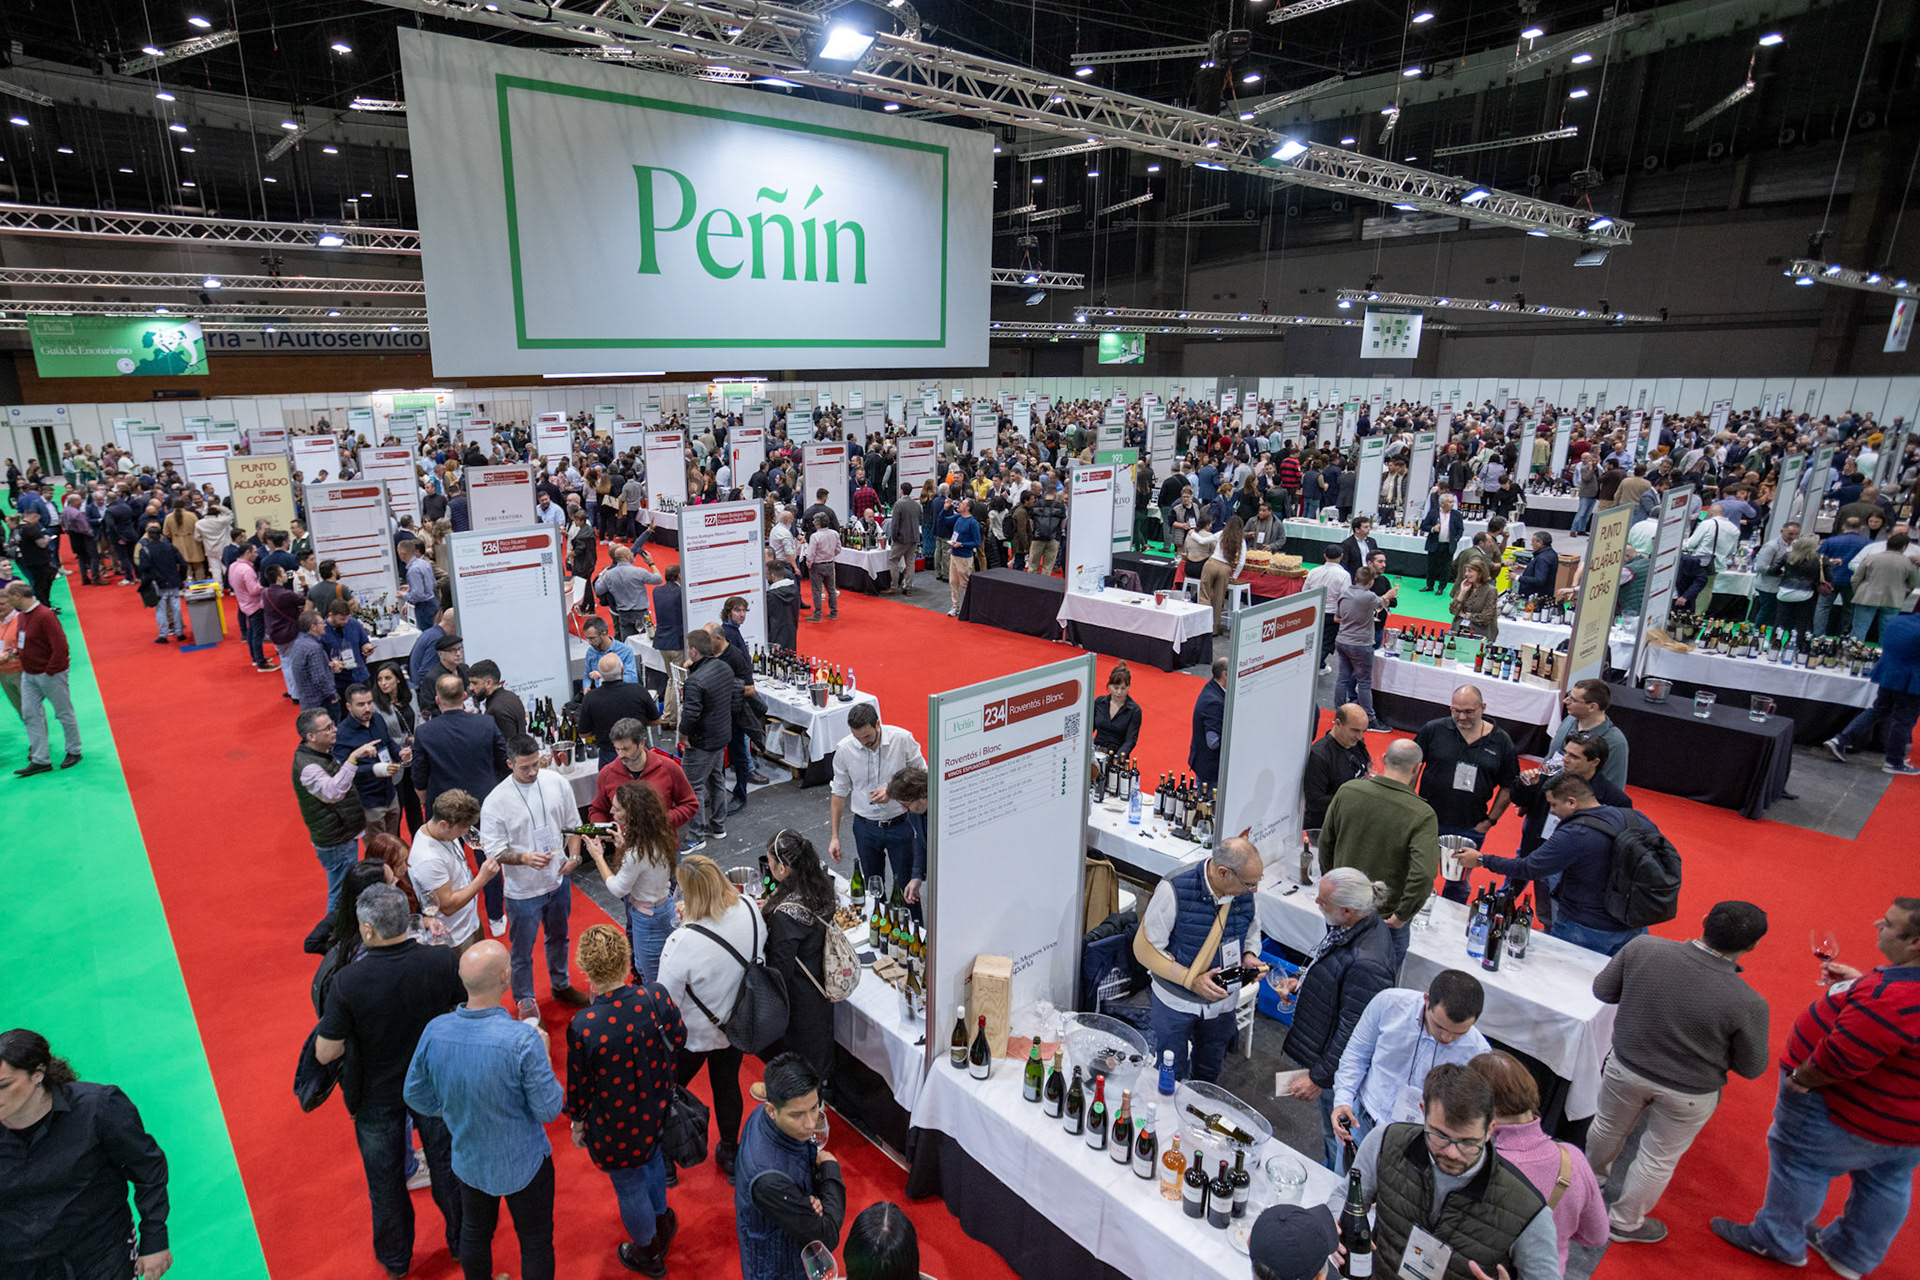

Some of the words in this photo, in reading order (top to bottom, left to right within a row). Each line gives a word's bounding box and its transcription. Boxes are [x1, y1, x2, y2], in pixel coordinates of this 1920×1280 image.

[632, 165, 867, 284] Peñín
[278, 331, 423, 348] Autoservicio
[78, 345, 132, 356] Enoturismo
[1112, 454, 1123, 462] 193
[242, 462, 276, 472] PUNTO
[234, 478, 288, 490] ACLARADO
[246, 494, 281, 504] COPAS
[705, 516, 716, 525] 227
[1600, 521, 1622, 542] PUNTO
[483, 543, 498, 553] 236
[1589, 550, 1622, 573] ACLARADO
[1590, 580, 1612, 600] COPAS
[1286, 618, 1302, 628] Tamayo
[1263, 622, 1274, 639] 229
[1248, 654, 1264, 664] Tamayo
[1010, 698, 1041, 714] Raventós
[1046, 692, 1064, 704] Blanc
[954, 719, 974, 732] Peñín
[984, 706, 1006, 726] 234
[945, 748, 978, 767] Raventós
[983, 744, 1002, 756] Blanc
[963, 760, 990, 773] ESPUMOSOS
